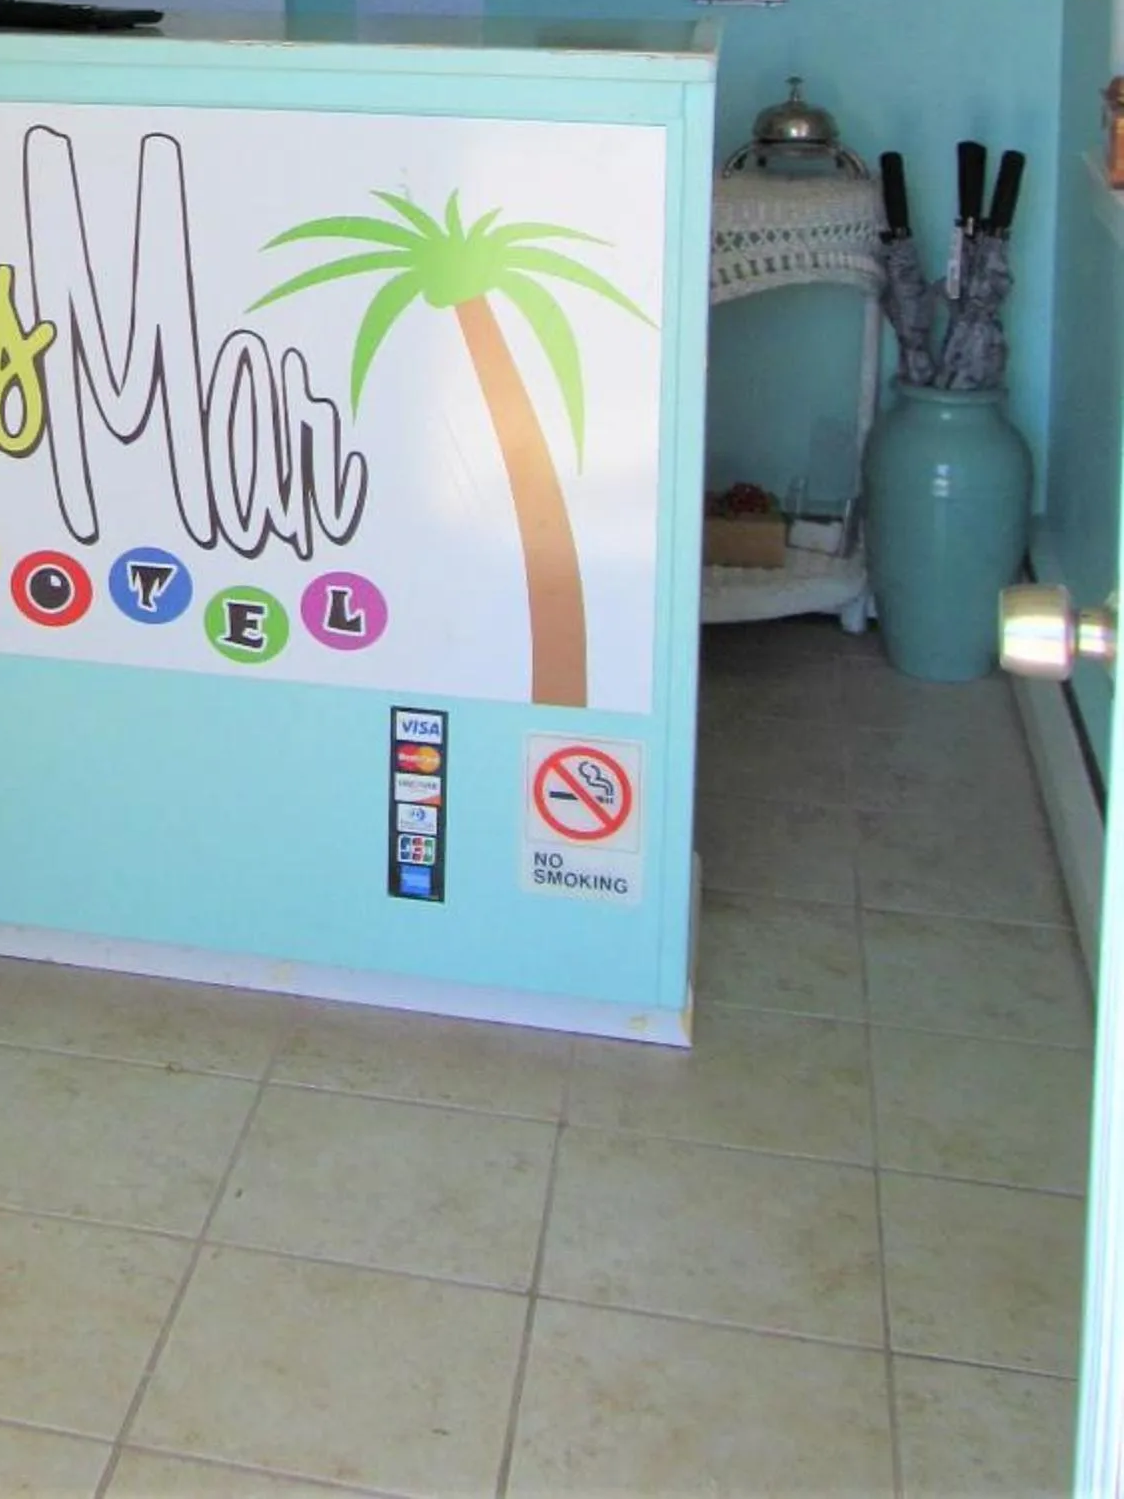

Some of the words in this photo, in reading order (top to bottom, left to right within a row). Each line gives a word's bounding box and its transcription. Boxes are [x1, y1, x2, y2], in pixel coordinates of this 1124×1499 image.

[401, 720, 440, 736] VISA
[533, 851, 564, 869] NO
[533, 869, 629, 895] SMOKING
